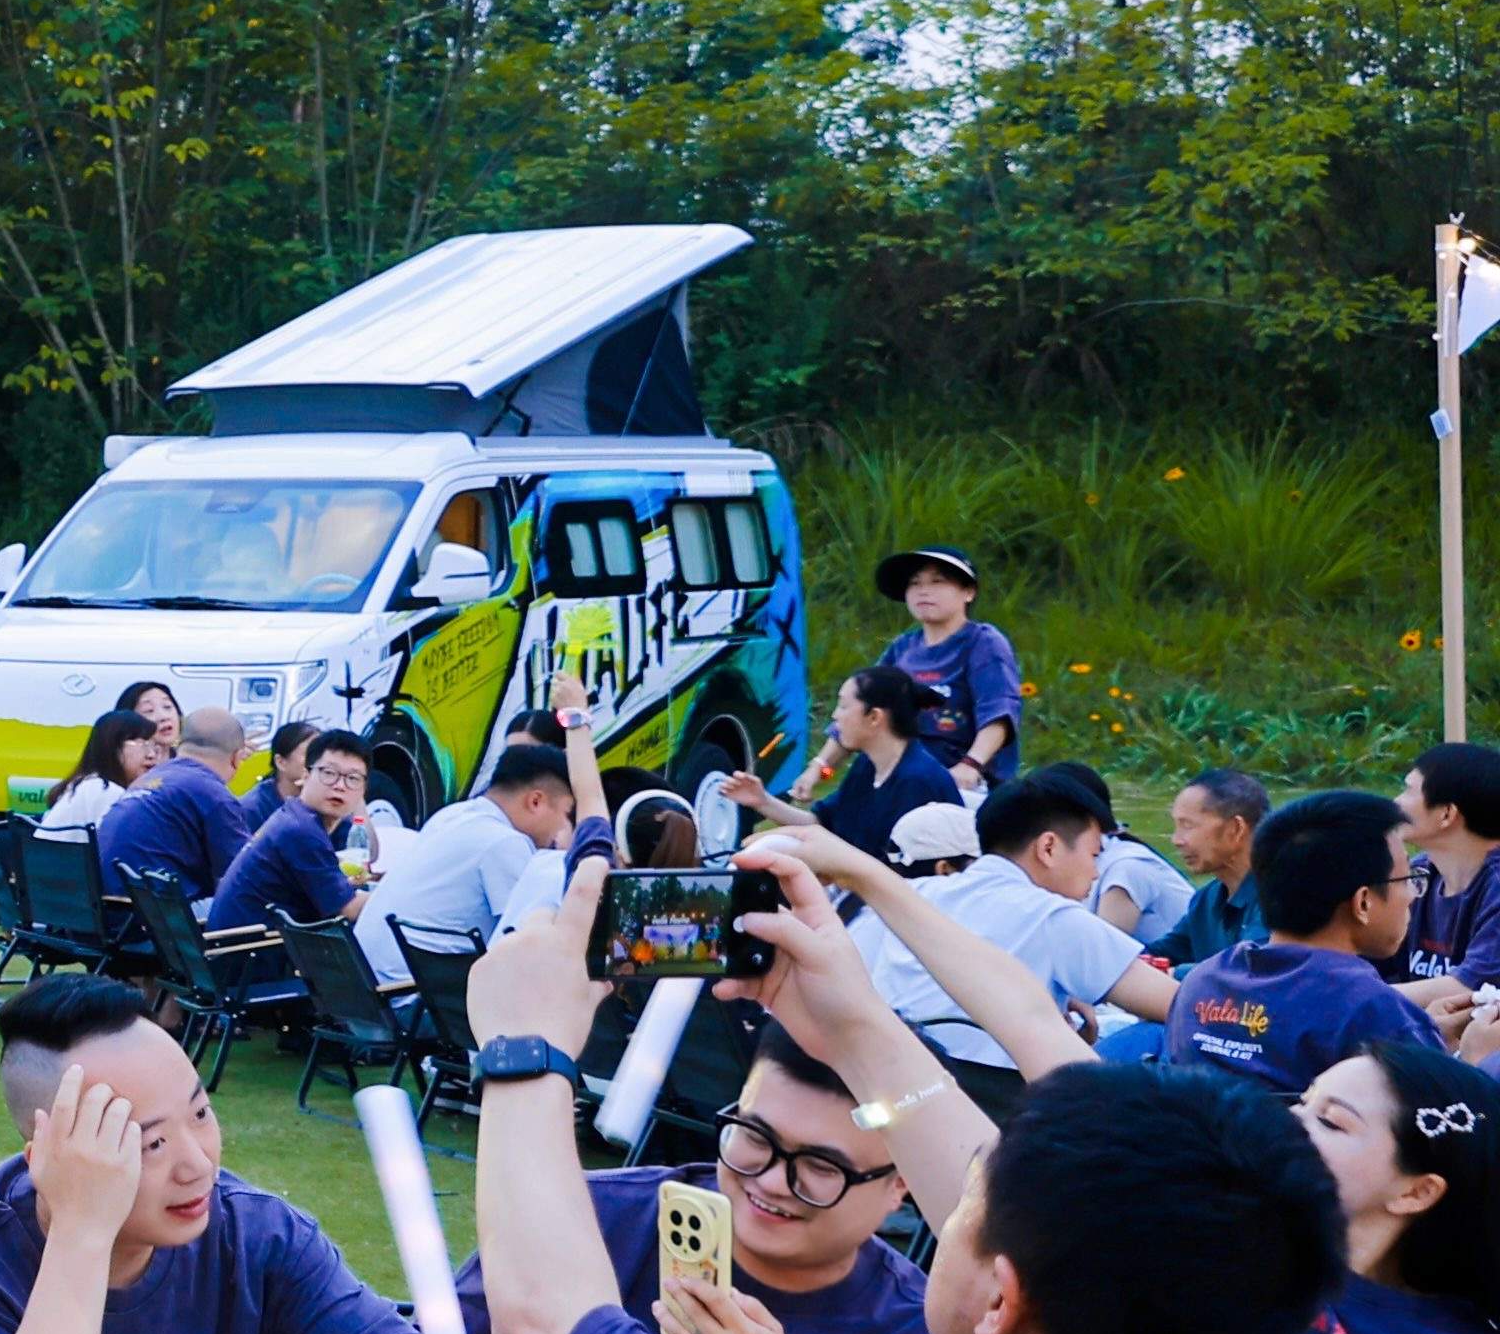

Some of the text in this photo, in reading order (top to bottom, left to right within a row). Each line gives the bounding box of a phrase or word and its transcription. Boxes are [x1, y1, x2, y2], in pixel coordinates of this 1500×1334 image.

[1409, 950, 1446, 977] Vala
[1194, 998, 1269, 1037] Vala Life
